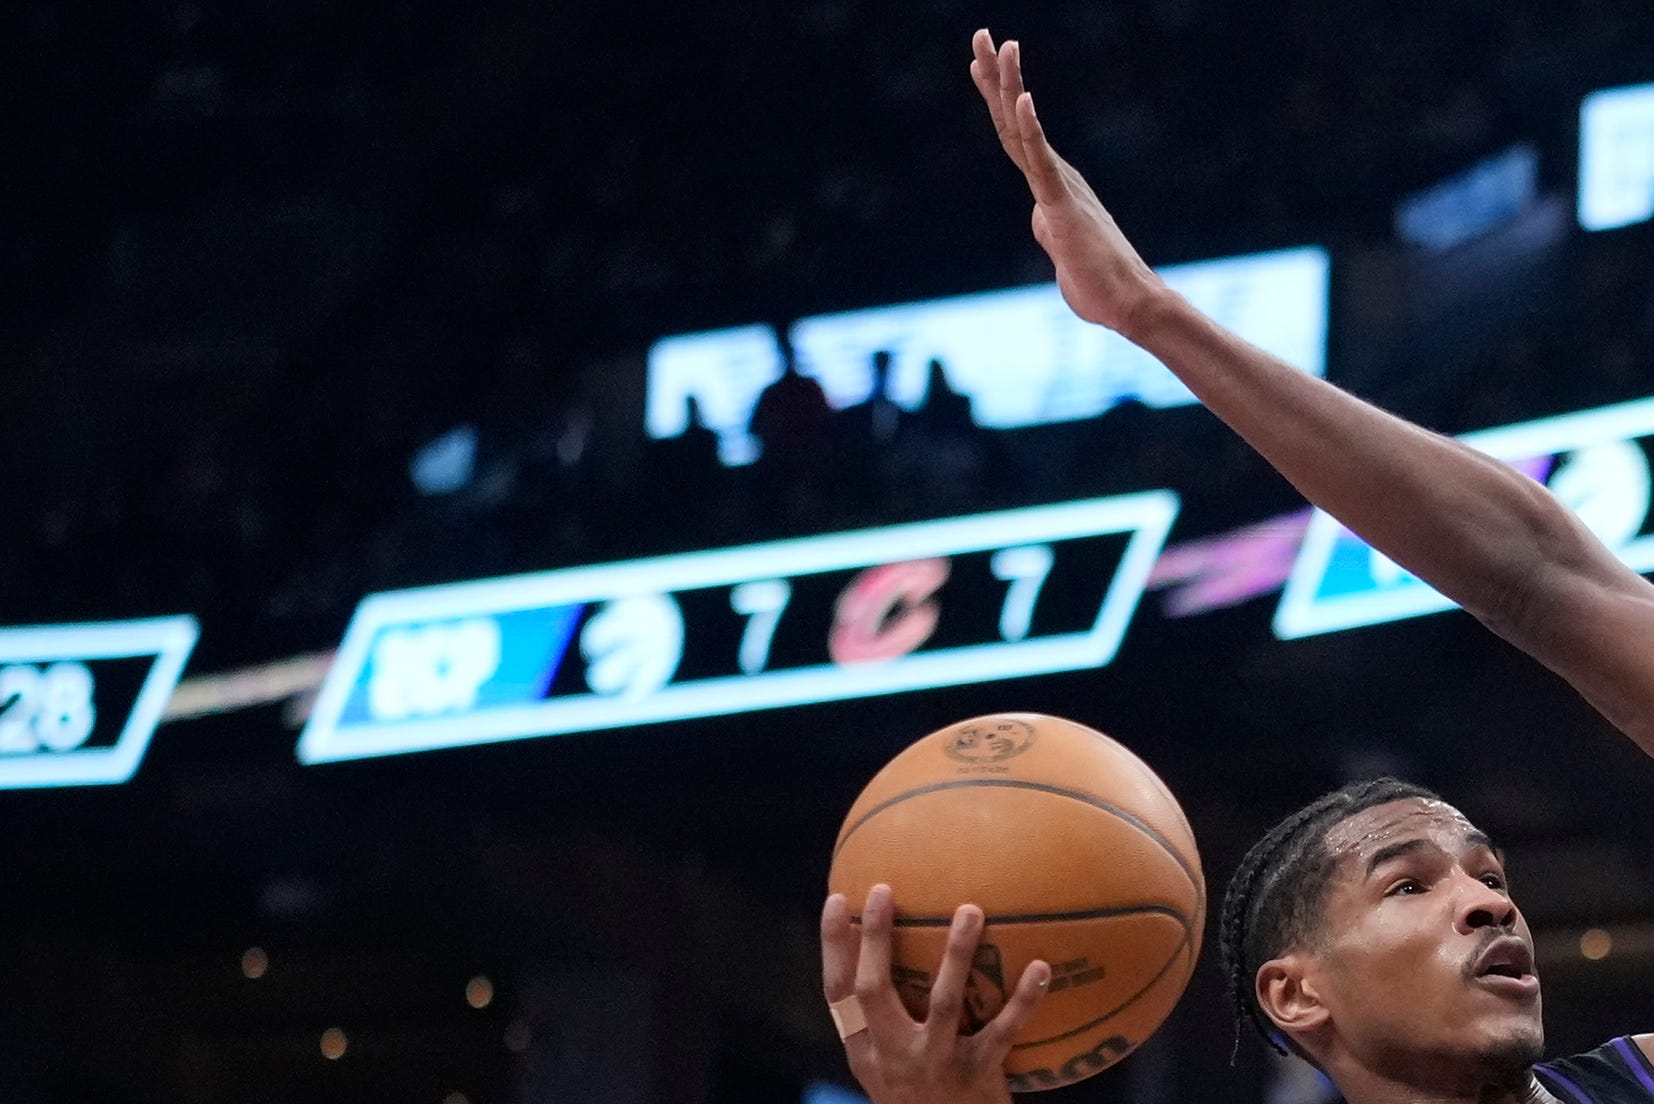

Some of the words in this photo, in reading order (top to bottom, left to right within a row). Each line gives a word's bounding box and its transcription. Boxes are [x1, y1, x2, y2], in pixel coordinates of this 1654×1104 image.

[730, 578, 791, 674] 7
[990, 544, 1055, 641] 7
[0, 661, 96, 753] 28
